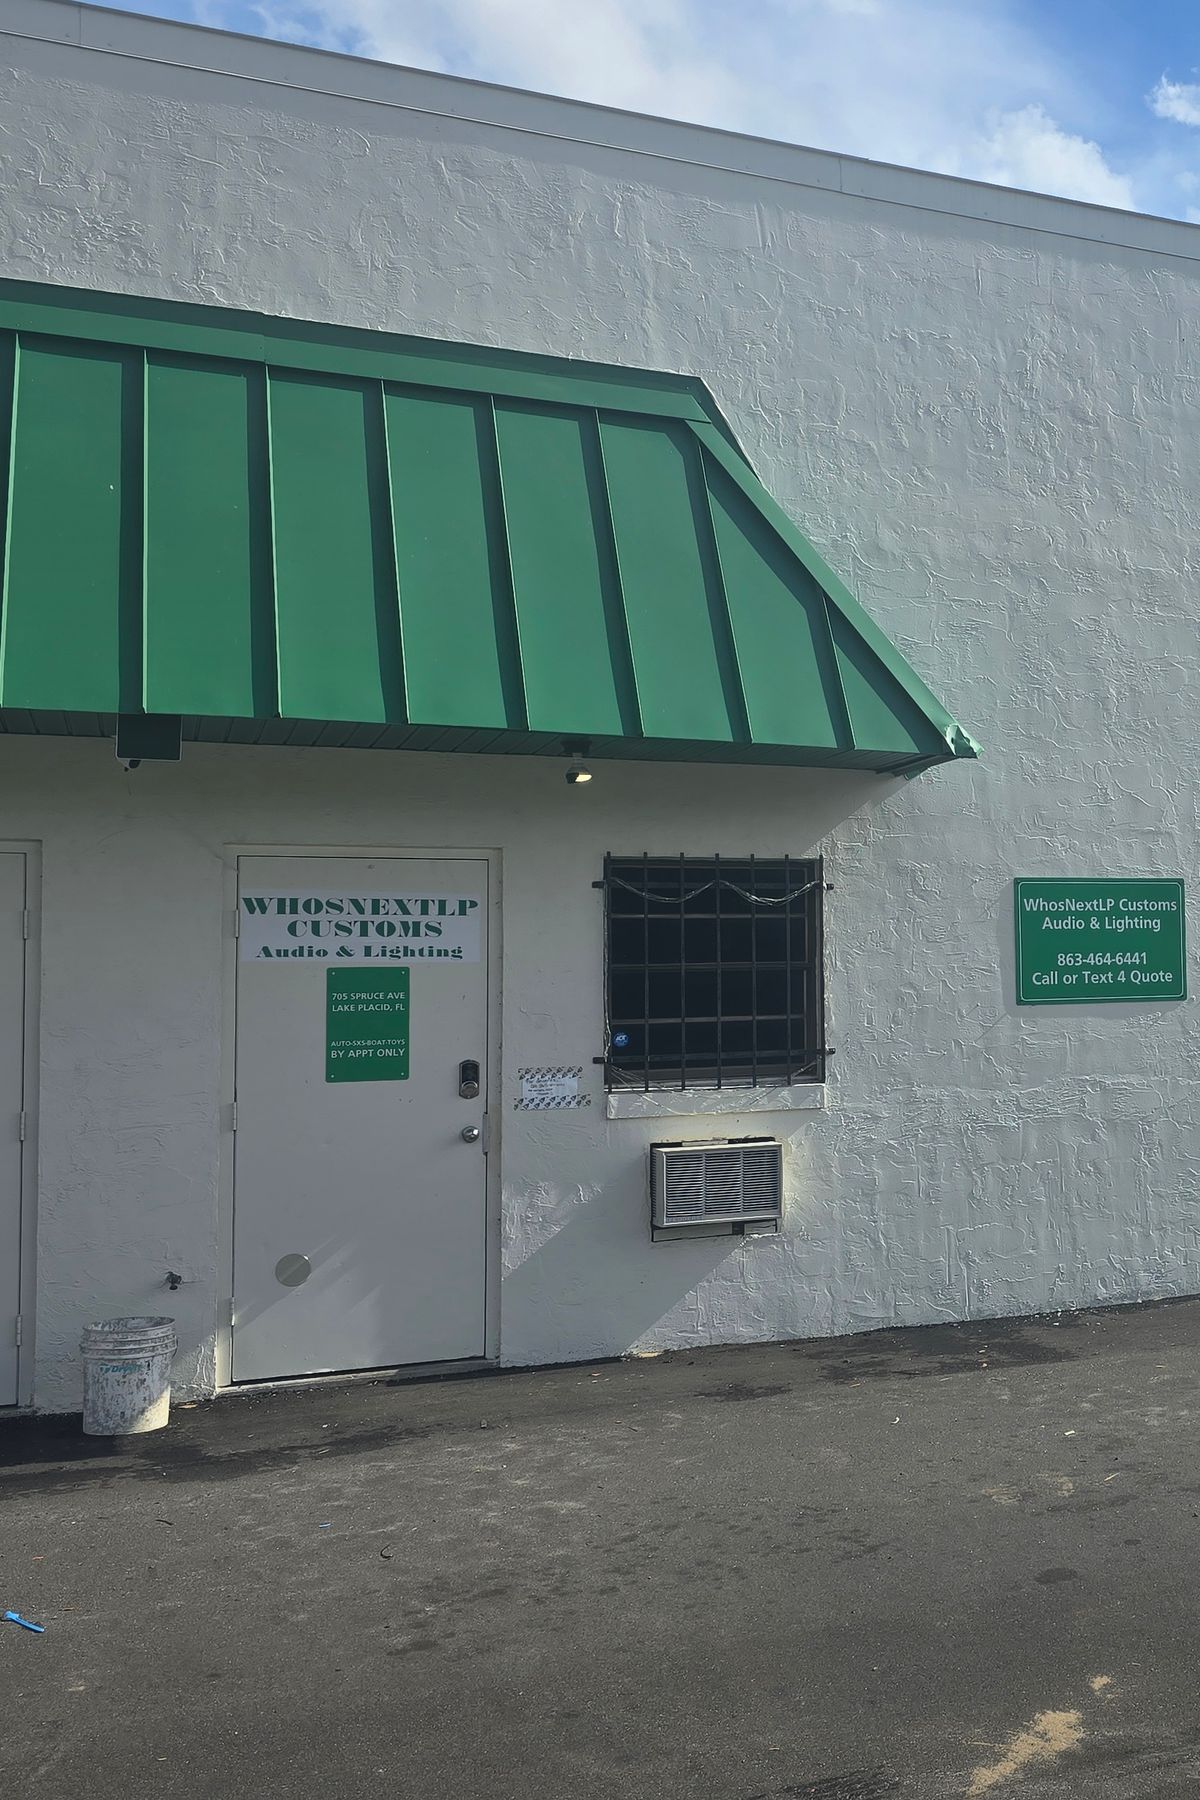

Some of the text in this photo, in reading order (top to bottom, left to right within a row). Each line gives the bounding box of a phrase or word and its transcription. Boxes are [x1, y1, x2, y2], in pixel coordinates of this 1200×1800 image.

[242, 897, 479, 917] WHOSNEXTLP
[1023, 898, 1178, 912] WhosNextLP Customs
[287, 919, 443, 938] CUSTOMS
[1042, 915, 1161, 932] Audio & Lighting
[256, 945, 464, 960] Audio & Lighting
[1057, 952, 1148, 966] 863-464-6441
[1032, 970, 1173, 985] Call or Text 4 Quote
[332, 991, 406, 1001] 705 SPRUCE AVE
[332, 1003, 406, 1012] LAKE PLACID, FL
[331, 1048, 406, 1058] BY APPT ONLY
